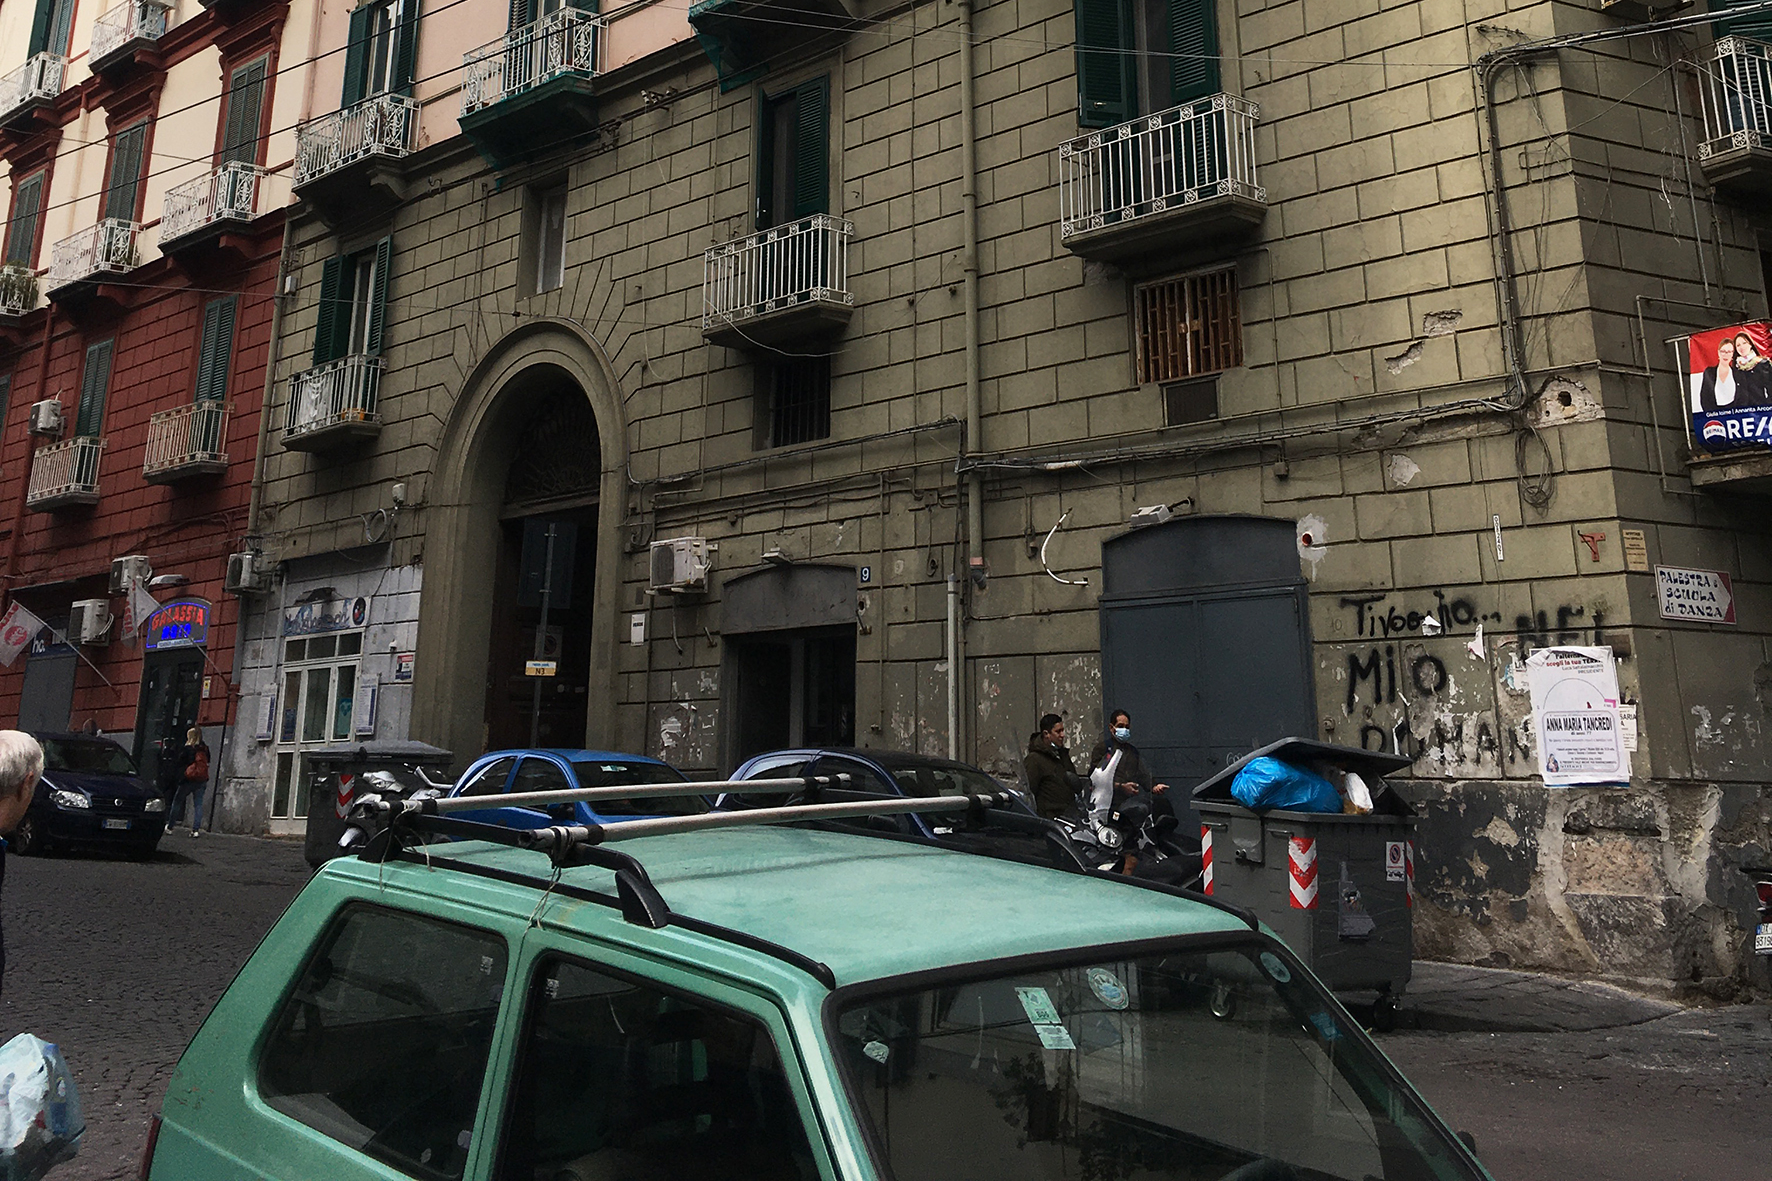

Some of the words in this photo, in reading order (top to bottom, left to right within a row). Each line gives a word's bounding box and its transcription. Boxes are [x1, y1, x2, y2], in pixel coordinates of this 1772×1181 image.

[1725, 416, 1772, 440] RE/
[862, 567, 870, 581] 9
[1659, 570, 1711, 588] PALESTRA
[1666, 587, 1716, 602] SCUOLA
[1665, 599, 1675, 614] di
[1677, 603, 1723, 618] DANZA
[151, 605, 204, 631] GALASSIA
[1546, 718, 1564, 732] ANNA
[1563, 717, 1583, 732] MARIA
[1582, 716, 1613, 731] TANCREDI
